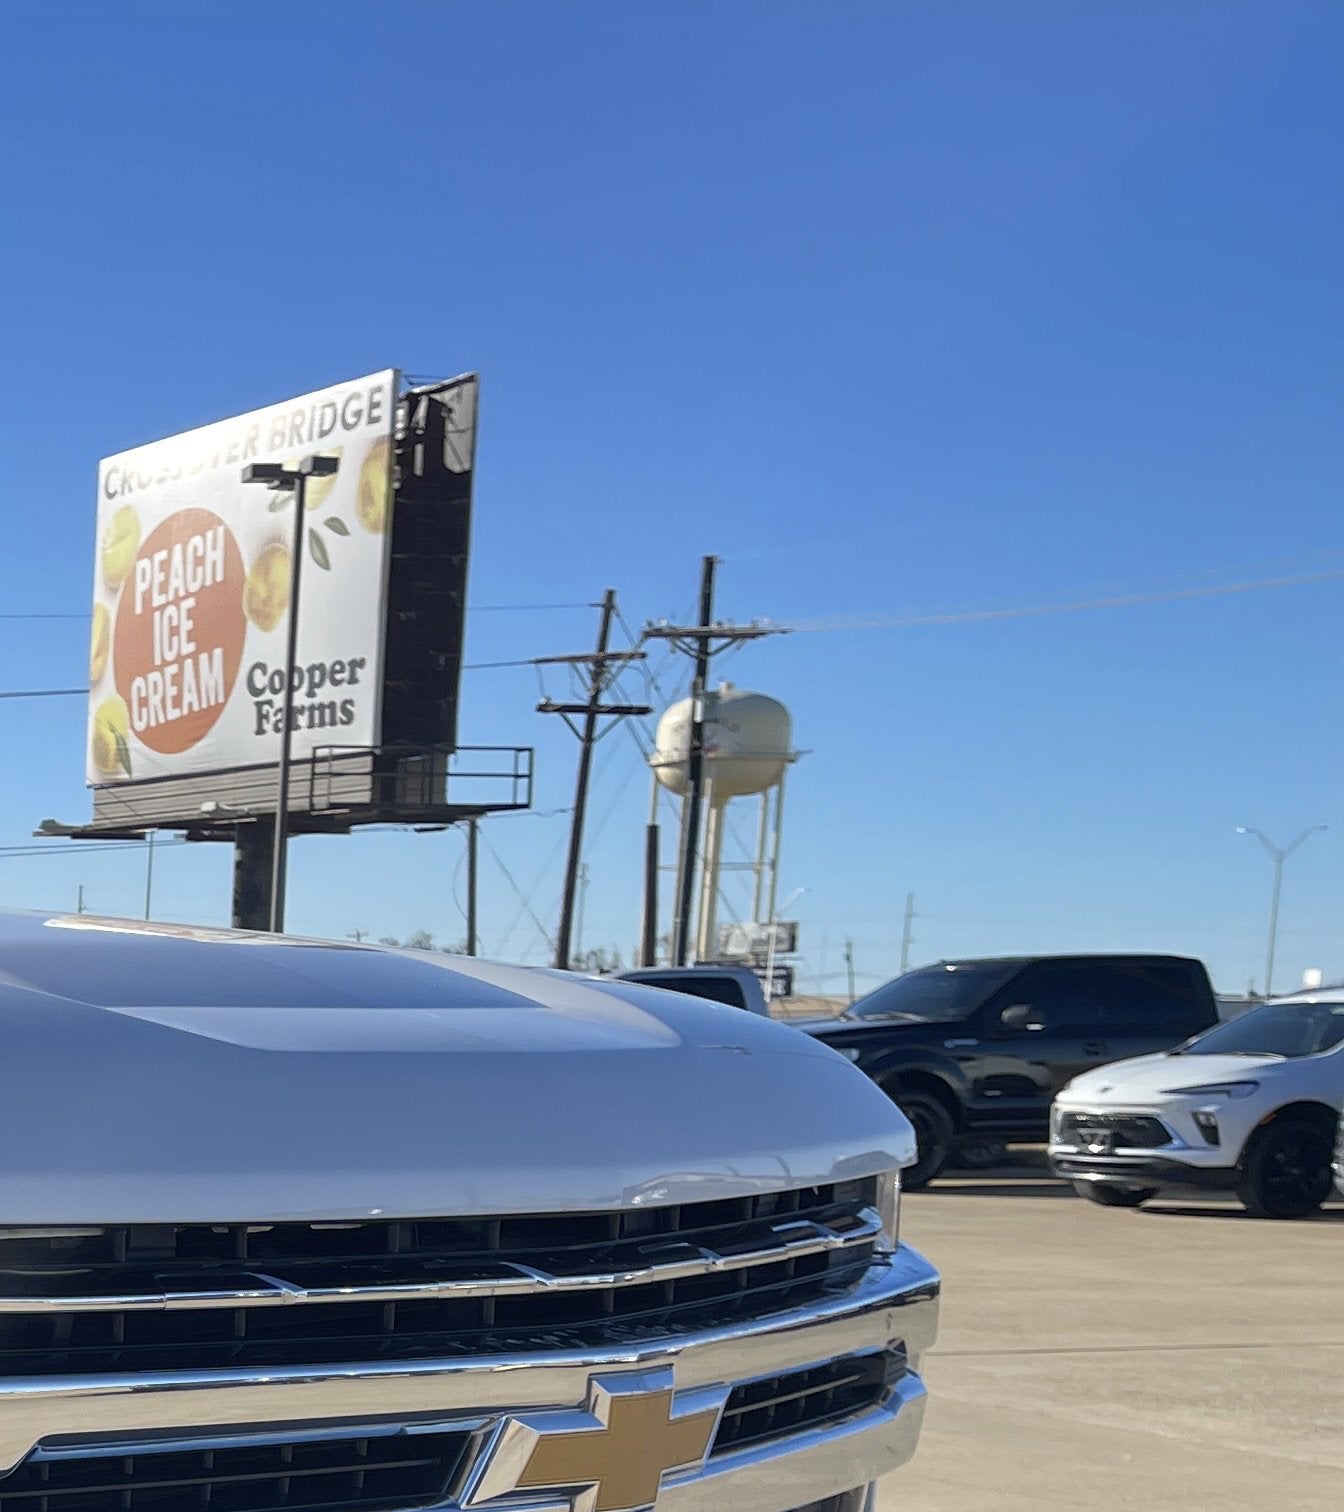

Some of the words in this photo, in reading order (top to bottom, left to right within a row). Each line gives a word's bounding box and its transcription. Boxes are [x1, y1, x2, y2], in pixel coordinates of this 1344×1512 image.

[104, 421, 262, 502] CROVER
[266, 384, 384, 452] BRIDGE
[134, 525, 226, 615] PEACH
[153, 597, 197, 666] ICE
[130, 647, 225, 732] CREAM
[247, 657, 366, 698] Cooper
[253, 698, 355, 736] Farms
